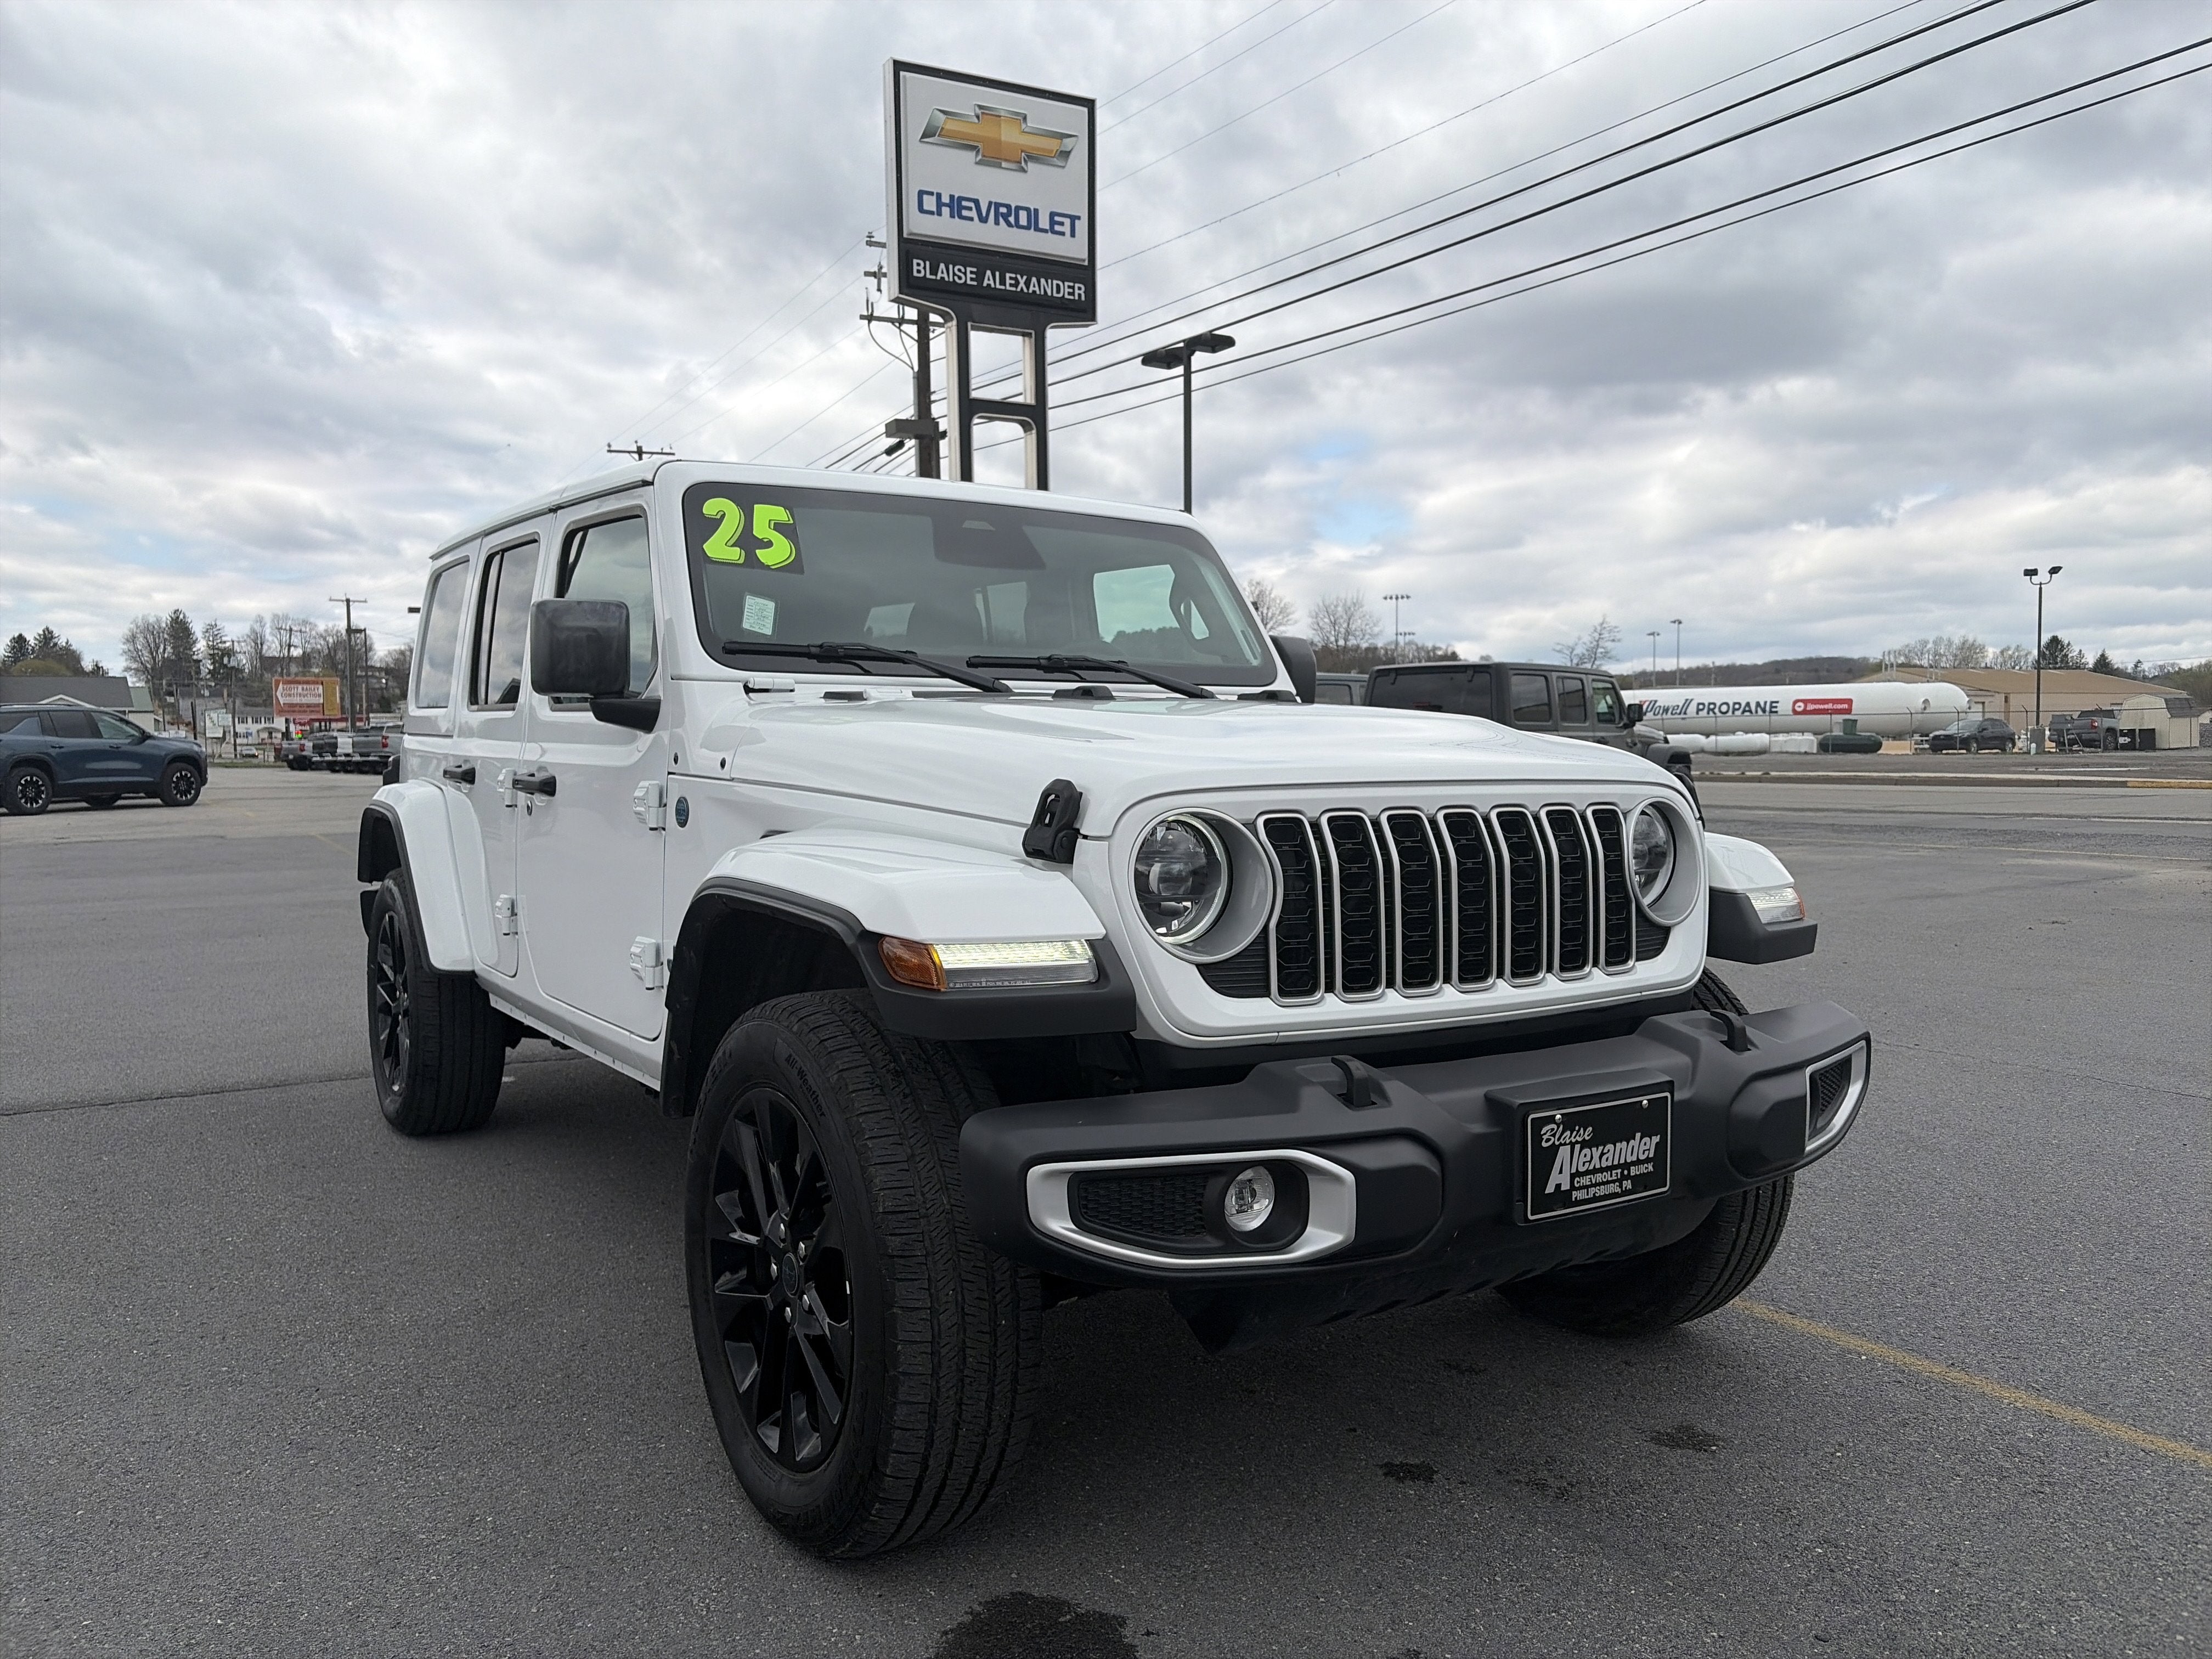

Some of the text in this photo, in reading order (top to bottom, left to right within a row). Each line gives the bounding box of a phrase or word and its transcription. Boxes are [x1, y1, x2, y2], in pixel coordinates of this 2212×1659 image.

[917, 189, 1081, 238] CHEVROLET
[912, 258, 1086, 301] BLAISE ALEXANDER
[703, 498, 796, 569] 25
[1696, 701, 1779, 715] PROPANE
[785, 1053, 826, 1118] All-Weather
[1541, 1124, 1593, 1148] Blaise
[1544, 1132, 1661, 1194] Alexander
[1574, 1162, 1654, 1188] CHEVROLET BUICK
[1572, 1180, 1632, 1201] PHILIPSBURG, PA
